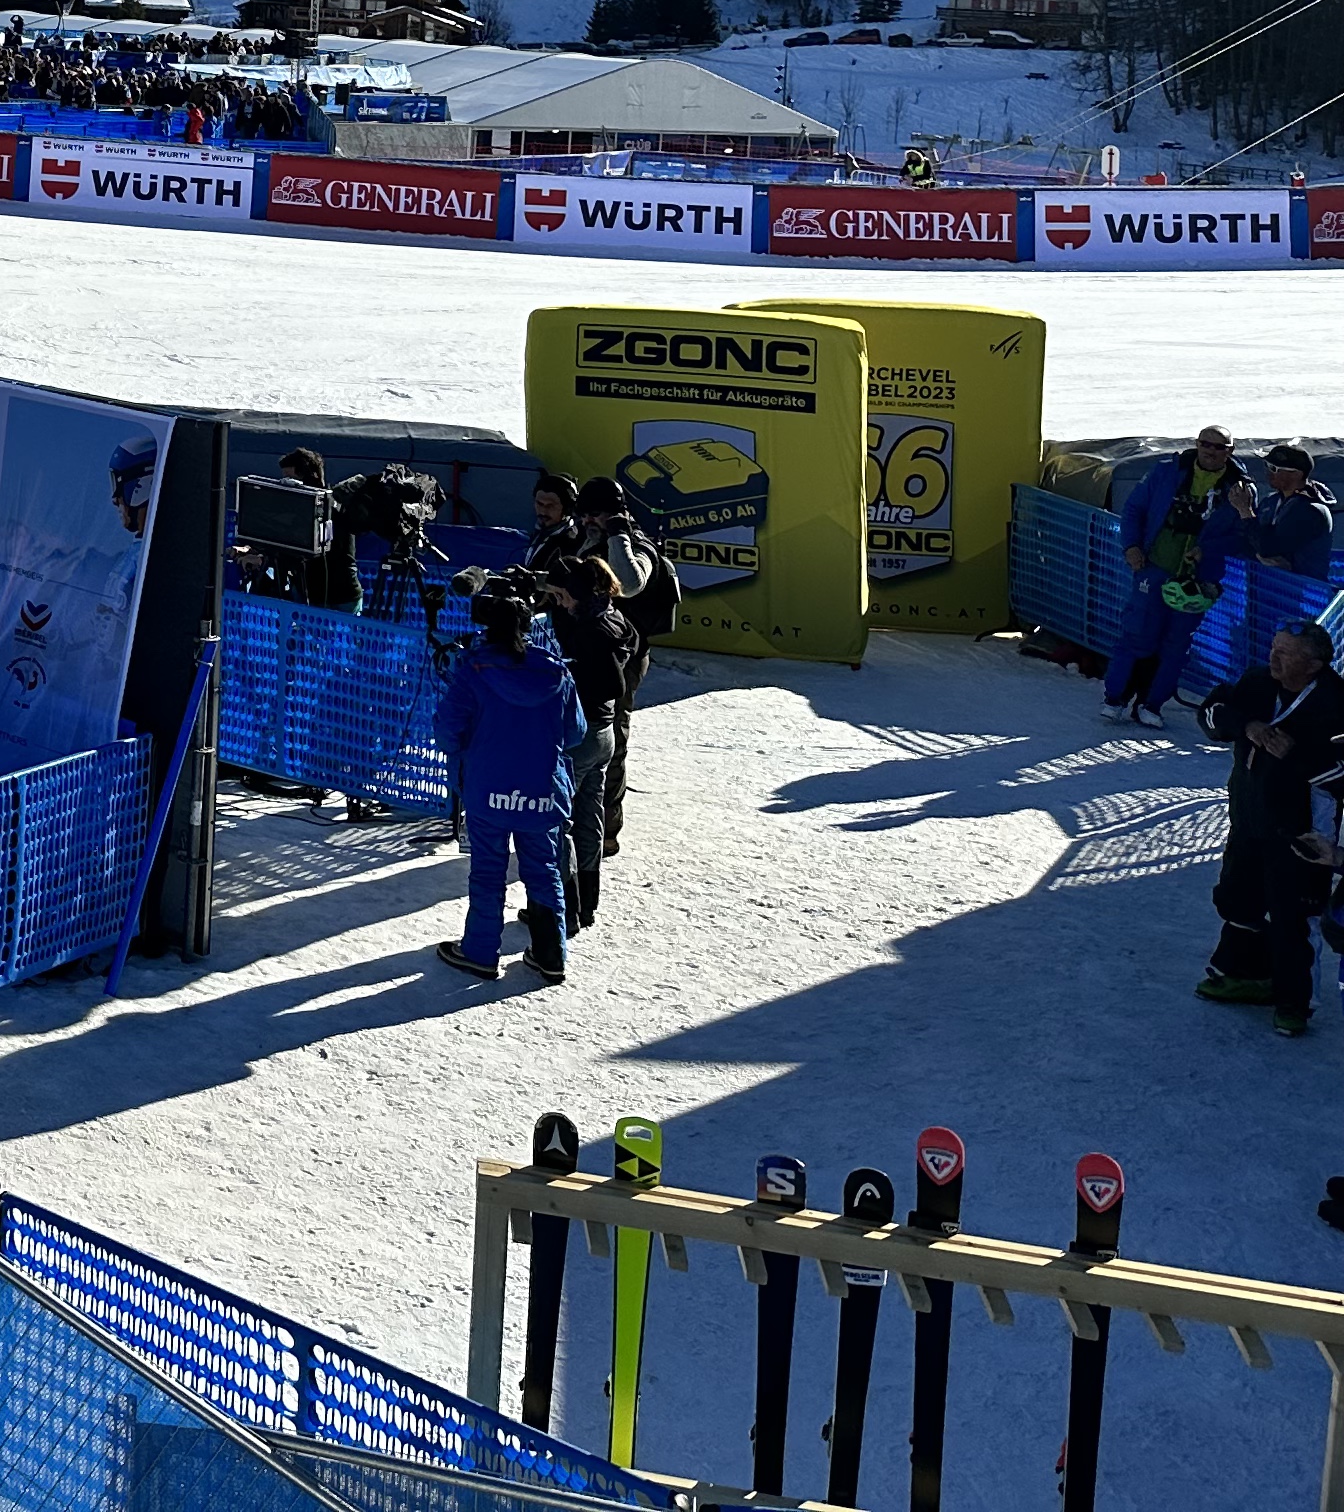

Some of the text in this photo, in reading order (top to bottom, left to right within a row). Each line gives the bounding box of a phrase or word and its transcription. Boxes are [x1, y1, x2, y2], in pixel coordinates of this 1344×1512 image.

[92, 169, 241, 208] WÜRTH
[325, 180, 496, 222] GENERALI
[579, 199, 742, 236] WÜRTH
[829, 209, 1012, 244] GENERALI
[1104, 212, 1281, 245] WÜRTH
[582, 329, 812, 376] ZGONC
[868, 366, 957, 384] RCHEVEL
[589, 382, 806, 410] Ihr Fachgeschäft für Akkugeräte
[868, 383, 956, 401] BEL 2023
[669, 503, 757, 530] Akku 6,0 Ah
[868, 501, 913, 523] ahre
[868, 529, 951, 553] ONC
[871, 603, 986, 619] GONC.AT
[680, 614, 803, 638] GONC.AT
